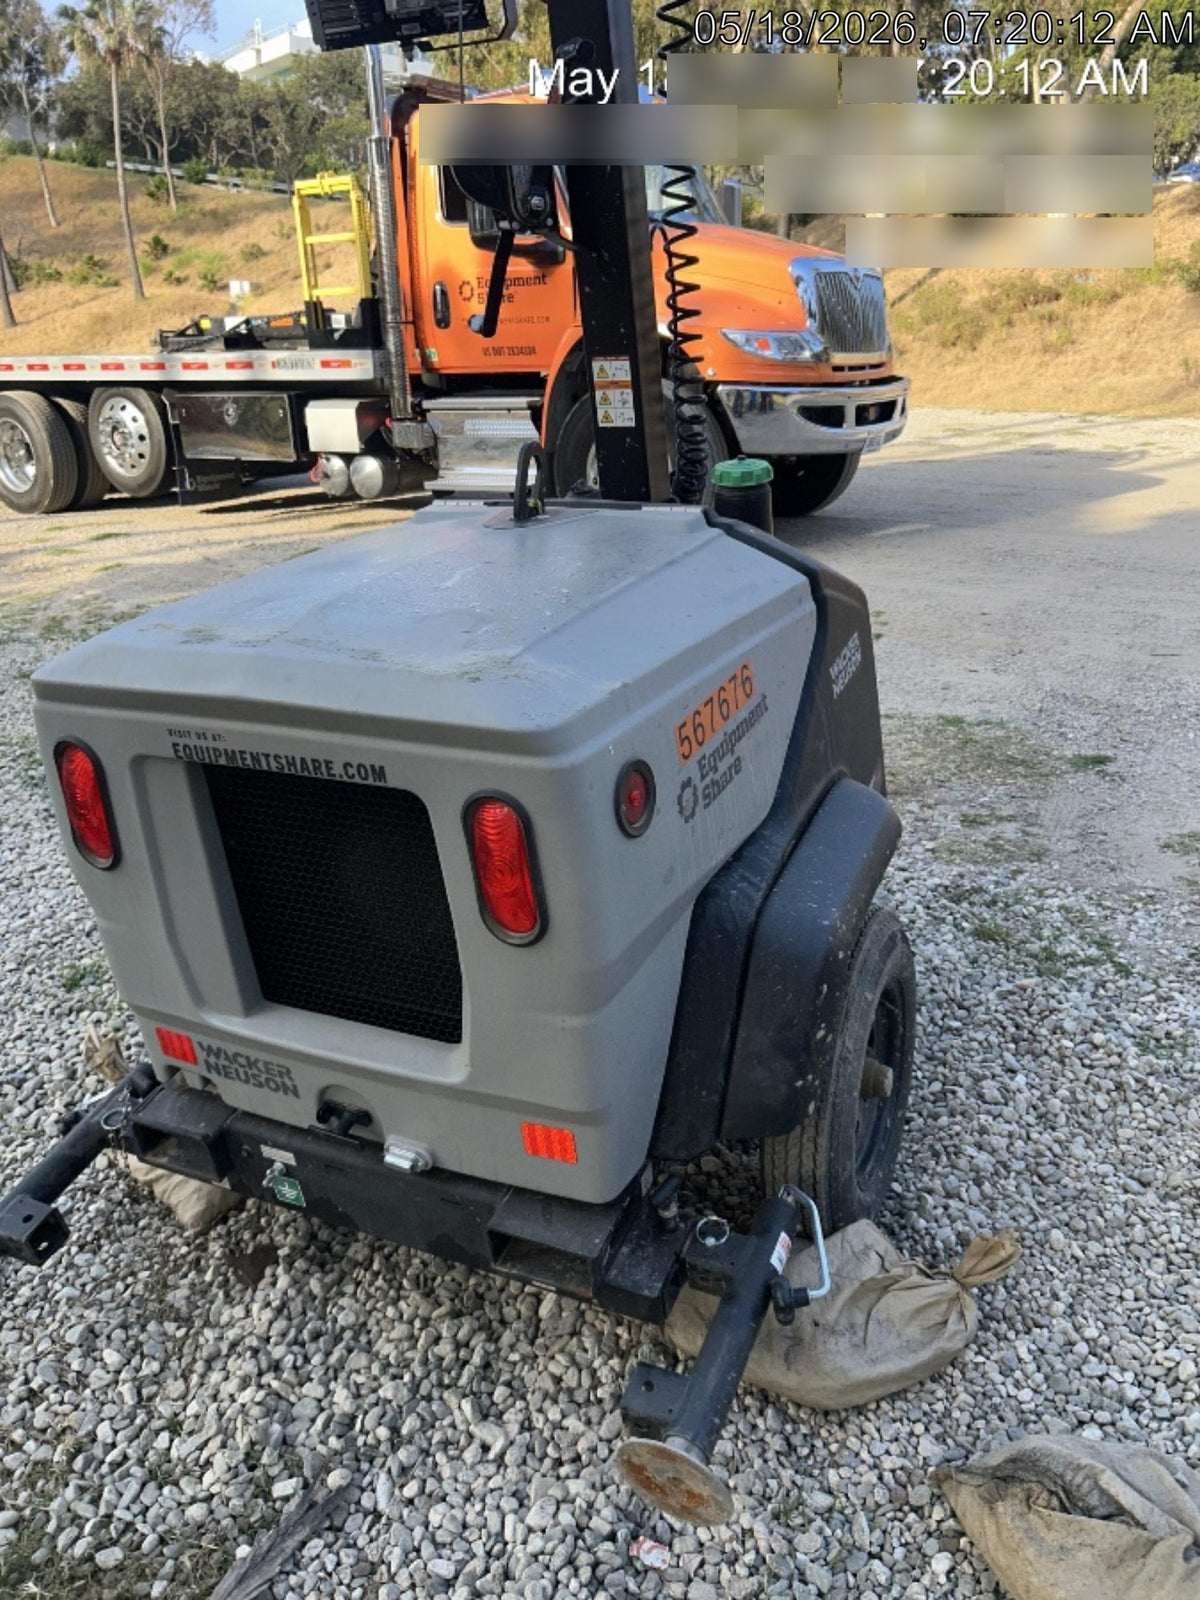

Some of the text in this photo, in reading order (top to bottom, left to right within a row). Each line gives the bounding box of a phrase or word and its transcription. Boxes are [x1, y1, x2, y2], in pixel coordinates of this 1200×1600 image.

[829, 632, 859, 679] WACKER
[832, 646, 861, 699] NEUSON
[167, 728, 192, 739] VISIT
[195, 731, 208, 740] US
[678, 664, 753, 760] 567676
[697, 693, 769, 783] Equipment
[172, 742, 388, 784] EQUIPMENTSHARE.COM
[702, 755, 742, 810] Share
[197, 1041, 295, 1082] WACKER
[204, 1058, 300, 1099] NEUSON
